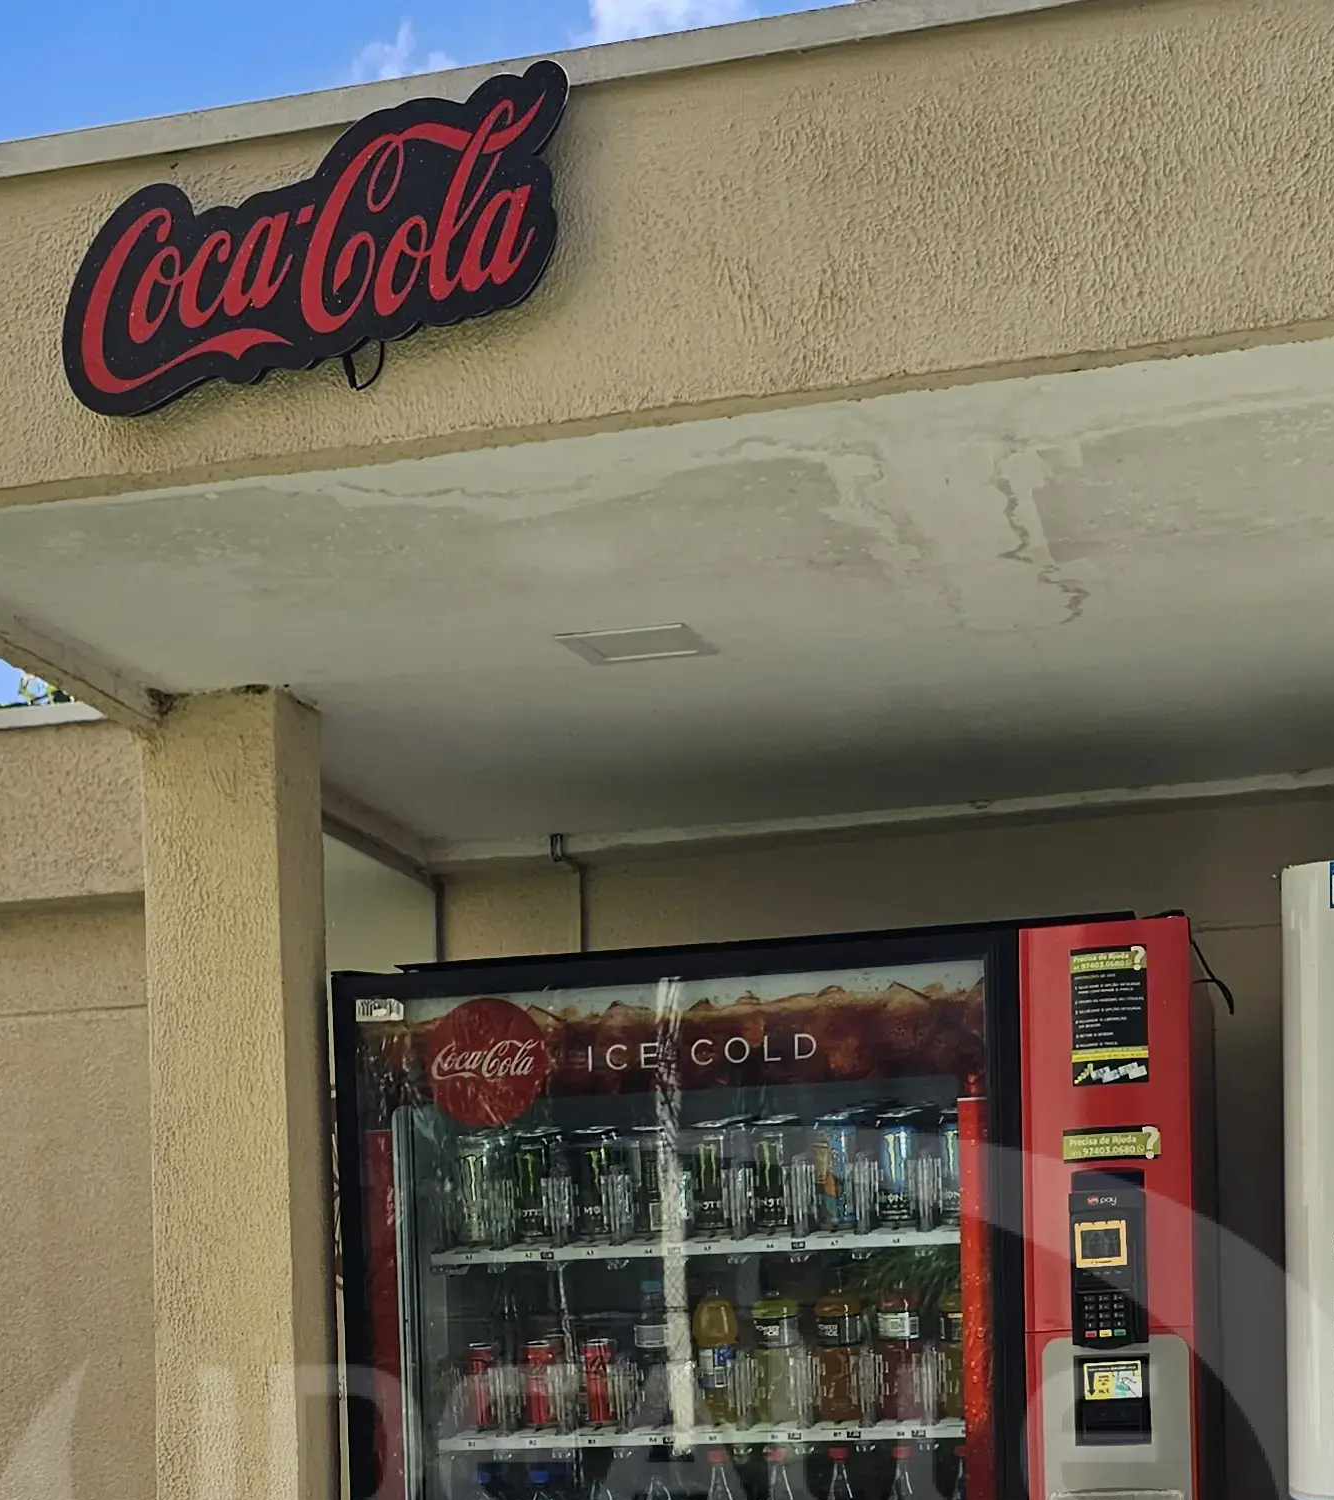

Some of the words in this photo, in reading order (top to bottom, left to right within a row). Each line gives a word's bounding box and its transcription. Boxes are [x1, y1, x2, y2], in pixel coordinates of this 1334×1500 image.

[81, 91, 546, 393] Coca-Cola
[431, 1039, 539, 1080] Coca-Cola
[588, 1045, 662, 1072] ICE
[691, 1033, 818, 1067] COLD
[1100, 1196, 1117, 1206] pay
